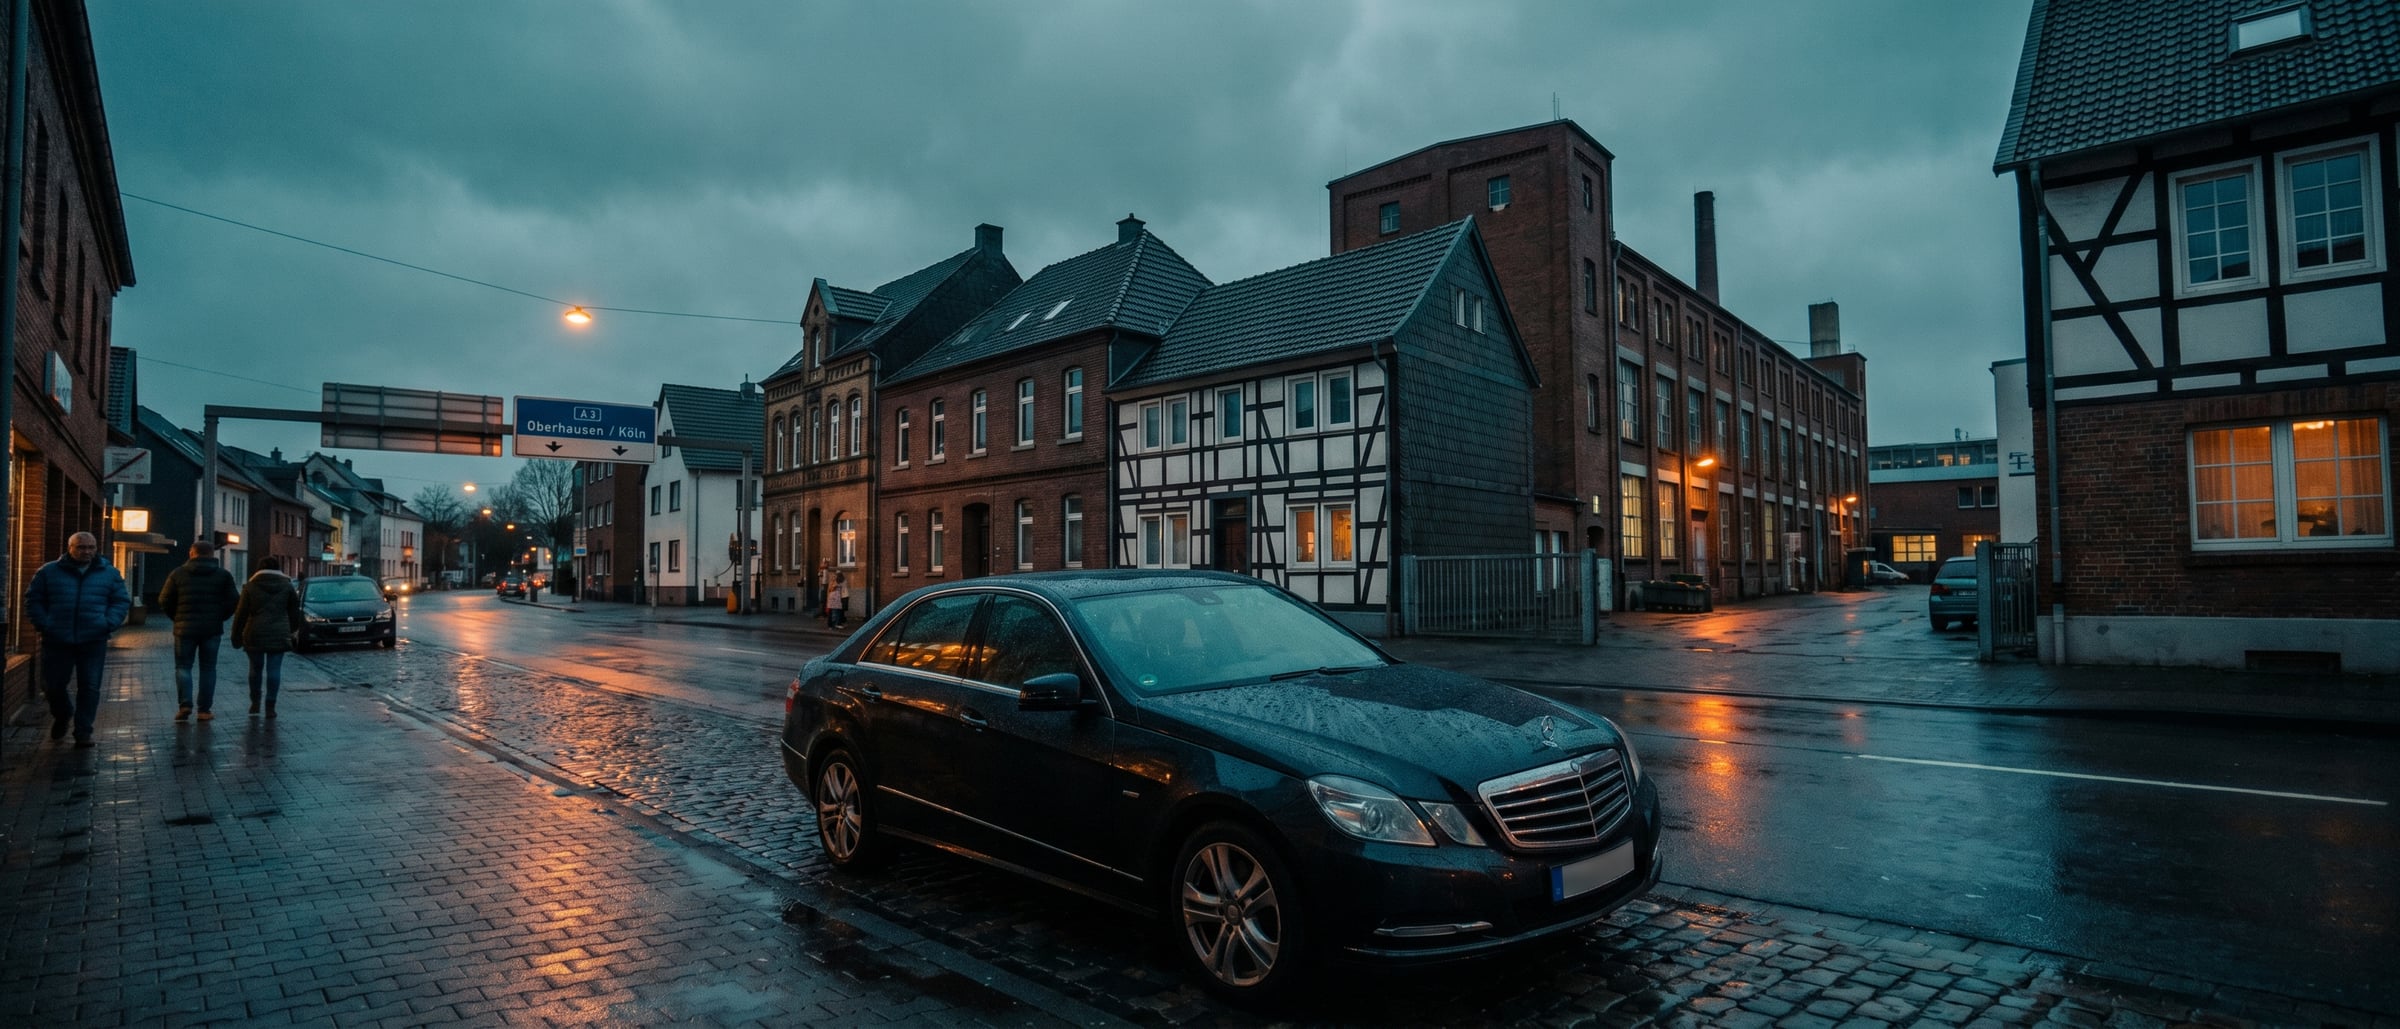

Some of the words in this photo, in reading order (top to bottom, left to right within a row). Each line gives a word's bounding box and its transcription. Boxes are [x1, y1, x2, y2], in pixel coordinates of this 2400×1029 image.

[580, 409, 588, 419] A
[590, 410, 596, 419] 3
[527, 420, 604, 436] Oberhausen
[609, 425, 614, 436] /
[619, 426, 646, 439] Köln
